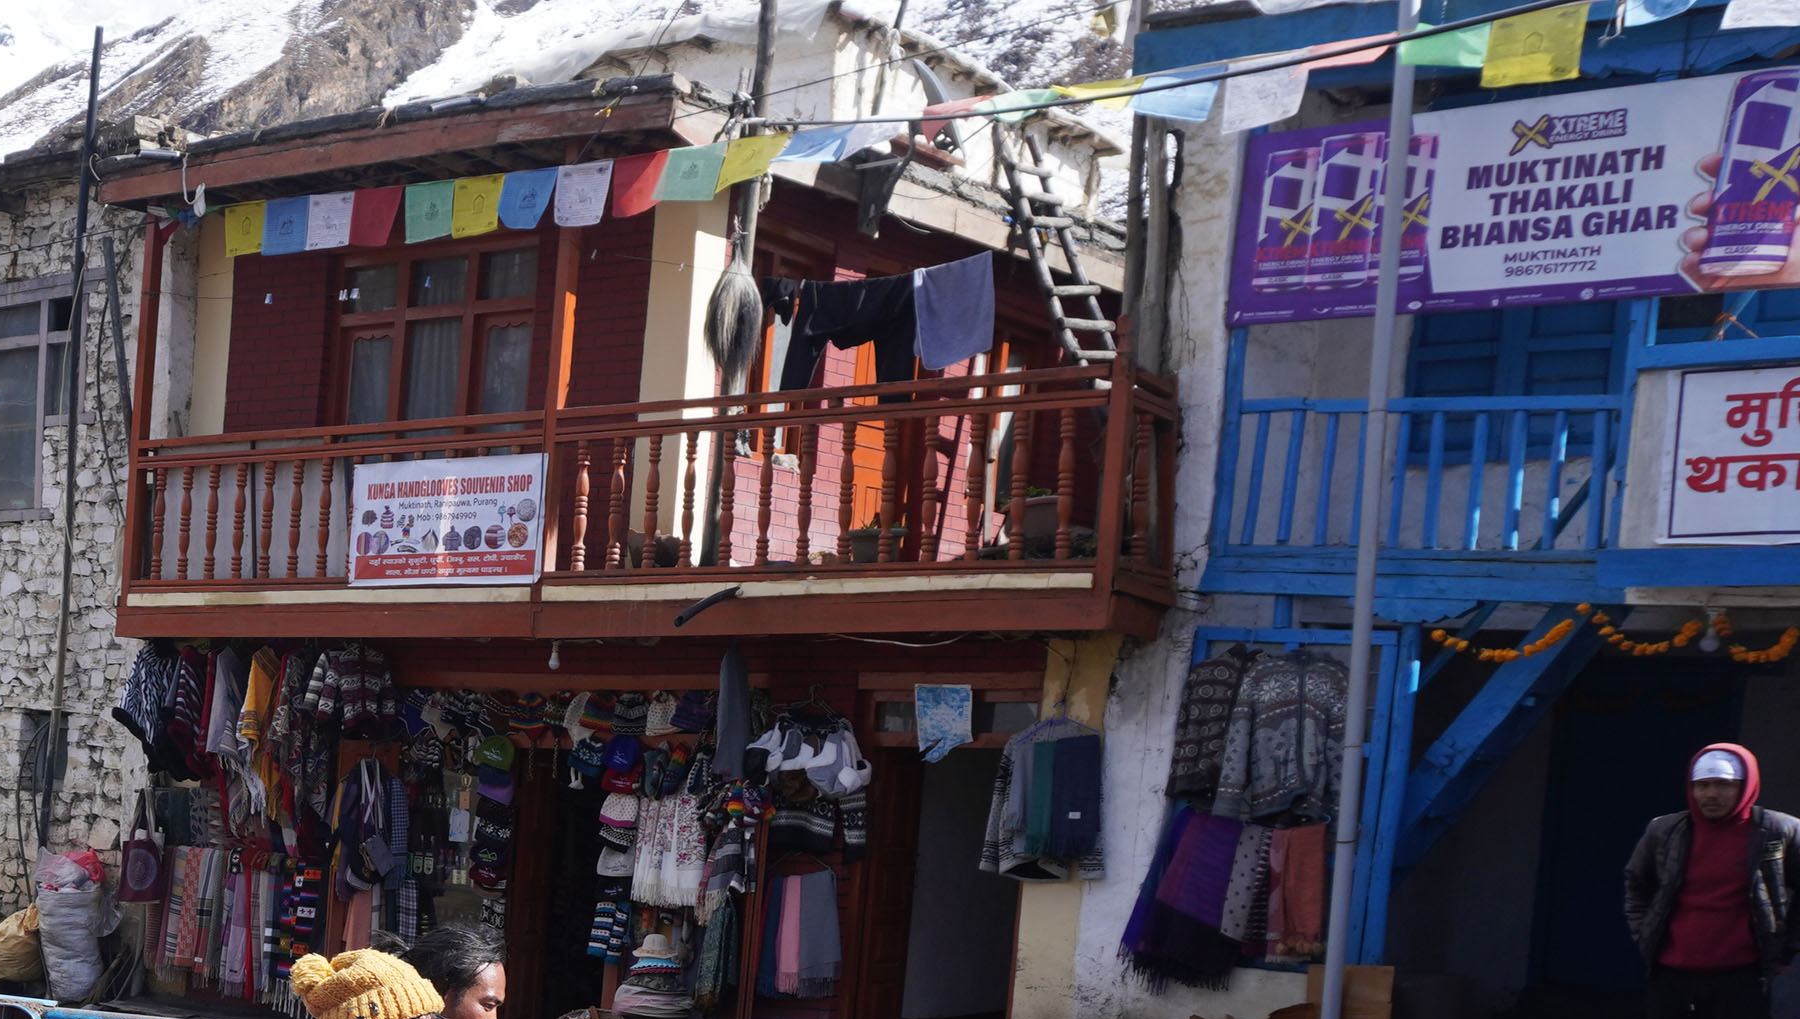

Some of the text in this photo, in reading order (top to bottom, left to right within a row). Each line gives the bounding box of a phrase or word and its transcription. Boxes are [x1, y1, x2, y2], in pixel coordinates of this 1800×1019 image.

[1552, 110, 1625, 134] XTREME
[1549, 127, 1625, 143] ENERGY DRINK
[1466, 145, 1666, 190] MUKTINATH
[1489, 178, 1634, 216] THAKALI
[1440, 214, 1573, 249] BHANSA
[1582, 204, 1680, 238] GHAR
[1504, 246, 1602, 264] MUKTINATH
[1505, 260, 1597, 278] 9867617772
[368, 474, 533, 500] KUNGA HANDGLOOVES SOUVENIR SHOP
[473, 497, 497, 507] Purang
